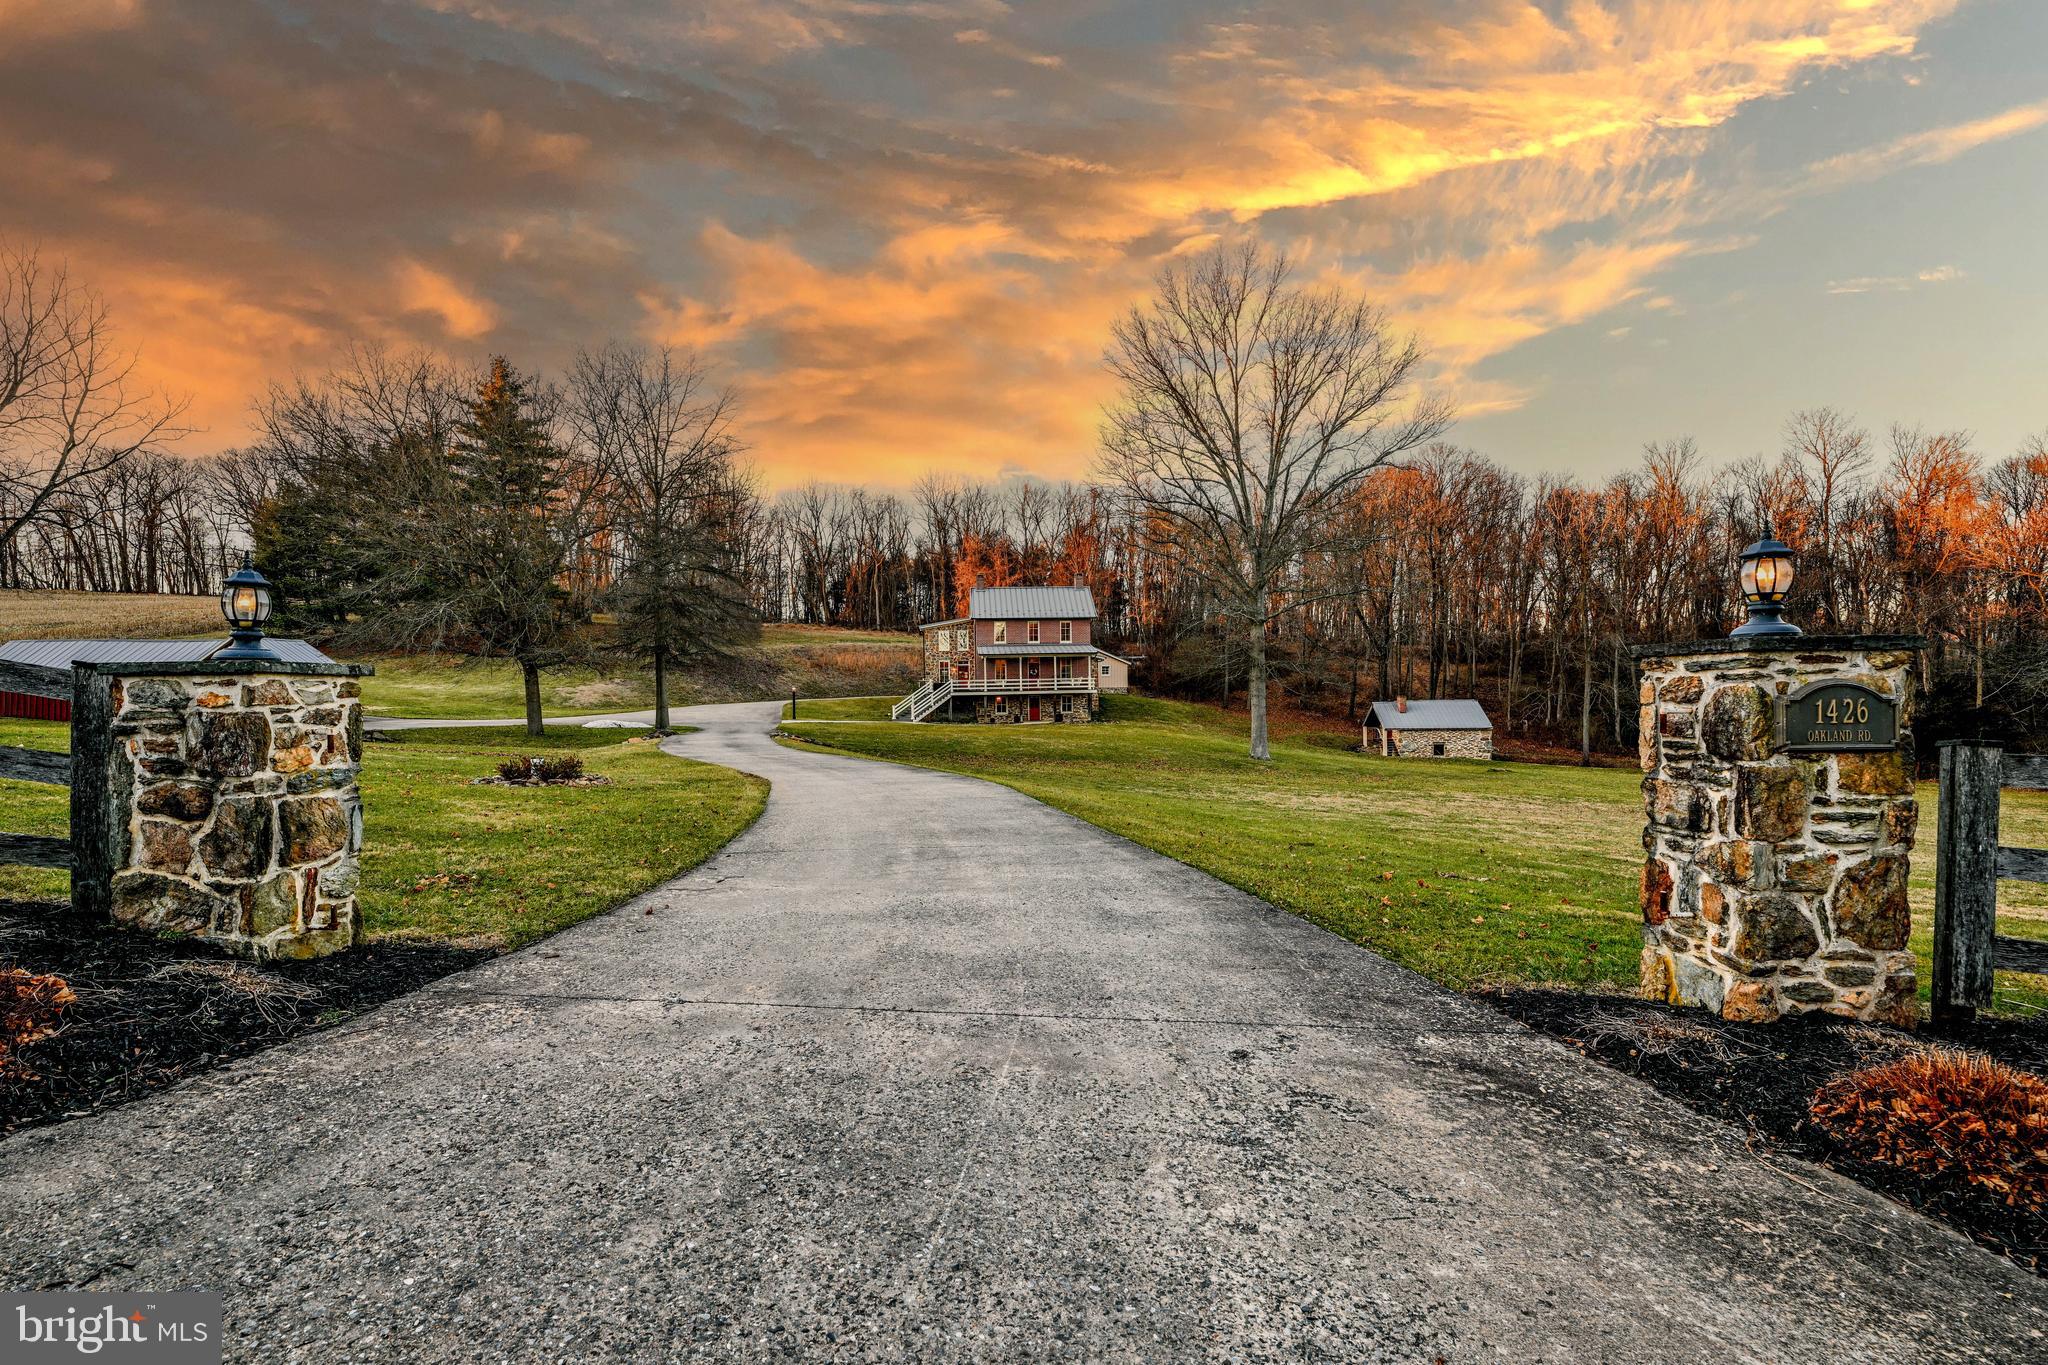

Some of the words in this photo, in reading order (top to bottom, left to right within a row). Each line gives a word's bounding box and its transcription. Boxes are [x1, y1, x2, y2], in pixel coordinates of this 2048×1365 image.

[1815, 698, 1869, 724] 1426
[1807, 729, 1853, 742] OAKLAND
[1858, 729, 1873, 742] RD.
